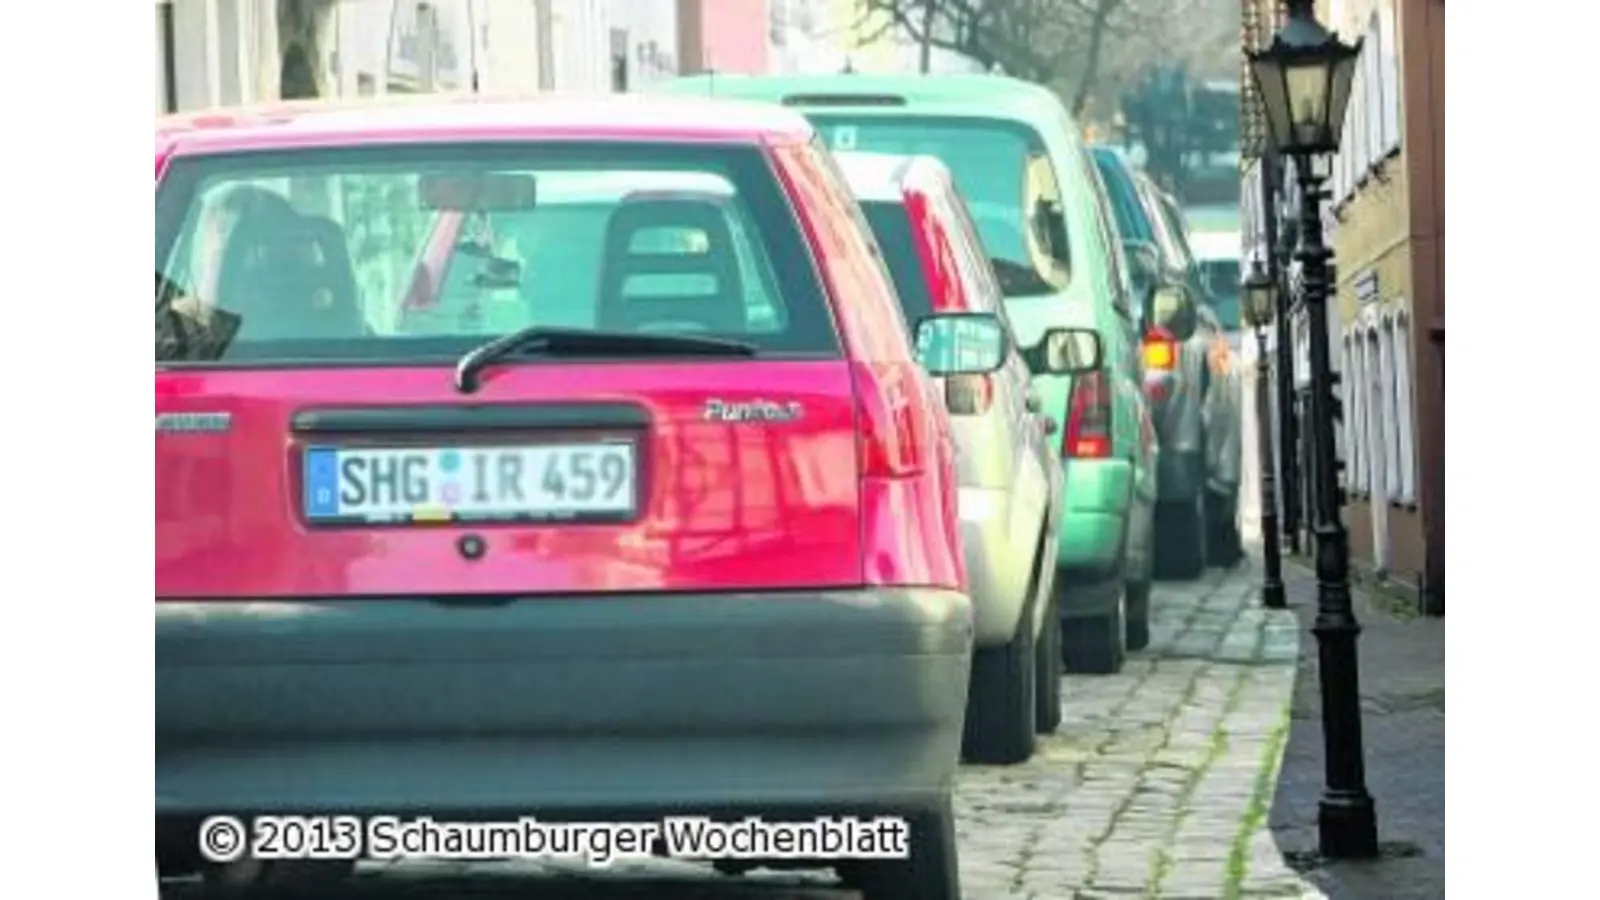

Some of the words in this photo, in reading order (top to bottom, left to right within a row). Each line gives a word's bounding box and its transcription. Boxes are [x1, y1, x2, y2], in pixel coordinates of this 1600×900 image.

[341, 455, 428, 506] SHG
[472, 454, 523, 502] IR
[541, 452, 626, 501] 459
